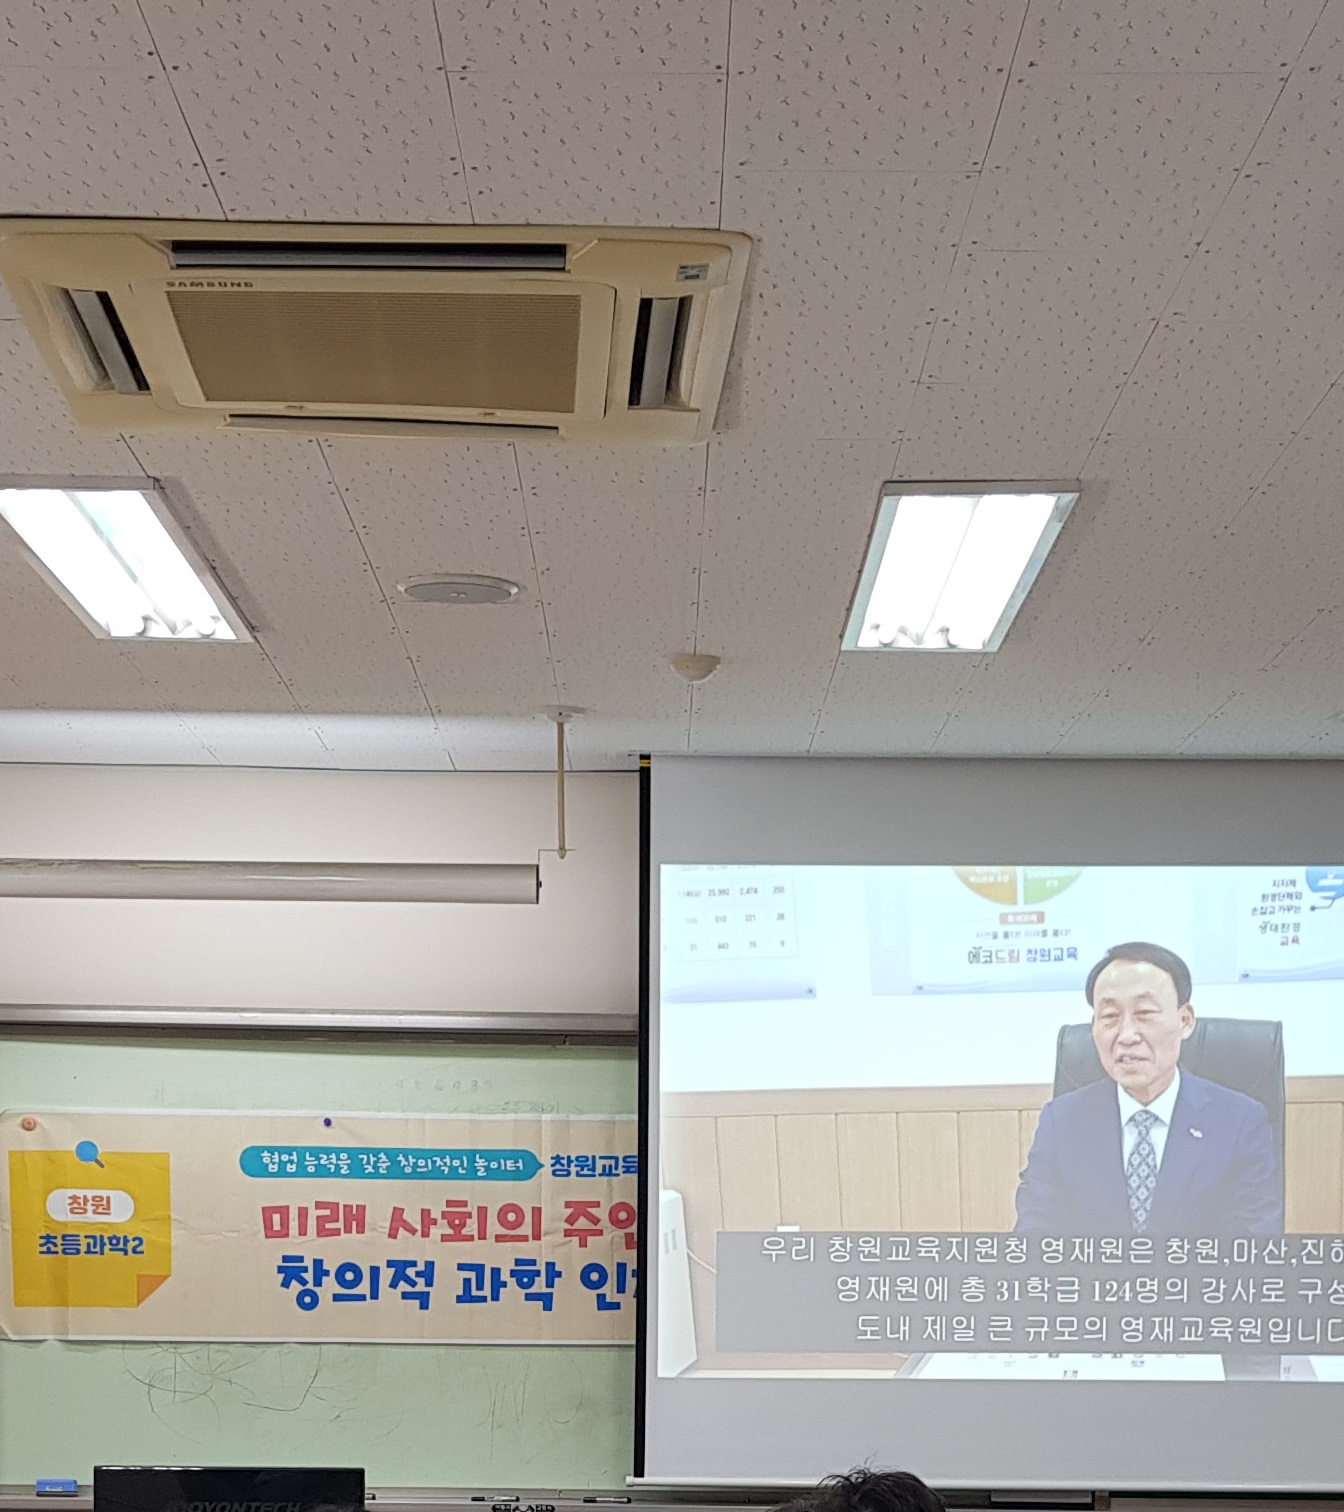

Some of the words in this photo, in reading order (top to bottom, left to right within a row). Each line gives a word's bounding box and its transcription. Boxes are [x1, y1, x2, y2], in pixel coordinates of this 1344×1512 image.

[1026, 947, 1078, 963] 창원교육
[261, 1151, 298, 1173] 협업
[304, 1152, 351, 1175] 능력을
[358, 1153, 391, 1174] 갖춘
[397, 1154, 468, 1175] 창의적인
[474, 1154, 524, 1176] 놀이터
[67, 1194, 112, 1216] 창원
[261, 1201, 367, 1239] 미래
[387, 1200, 543, 1243] 사회의
[38, 1233, 145, 1257] 초등과학2
[761, 1236, 816, 1263] 우리
[828, 1236, 1029, 1264] 창원교육지원청
[1041, 1236, 1154, 1265] 영재원은
[277, 1255, 436, 1312] 창의적
[456, 1258, 563, 1312] 과학
[580, 1261, 638, 1312] 인
[836, 1275, 949, 1303] 영재원에
[959, 1275, 987, 1302] 총
[996, 1275, 1081, 1303] 31학급
[1092, 1276, 1189, 1304] 124명의
[1201, 1277, 1287, 1304] 강사로
[856, 1314, 909, 1342] 도내
[922, 1314, 976, 1342] 제일
[987, 1315, 1013, 1342] 큰
[1024, 1314, 1108, 1342] 규모의
